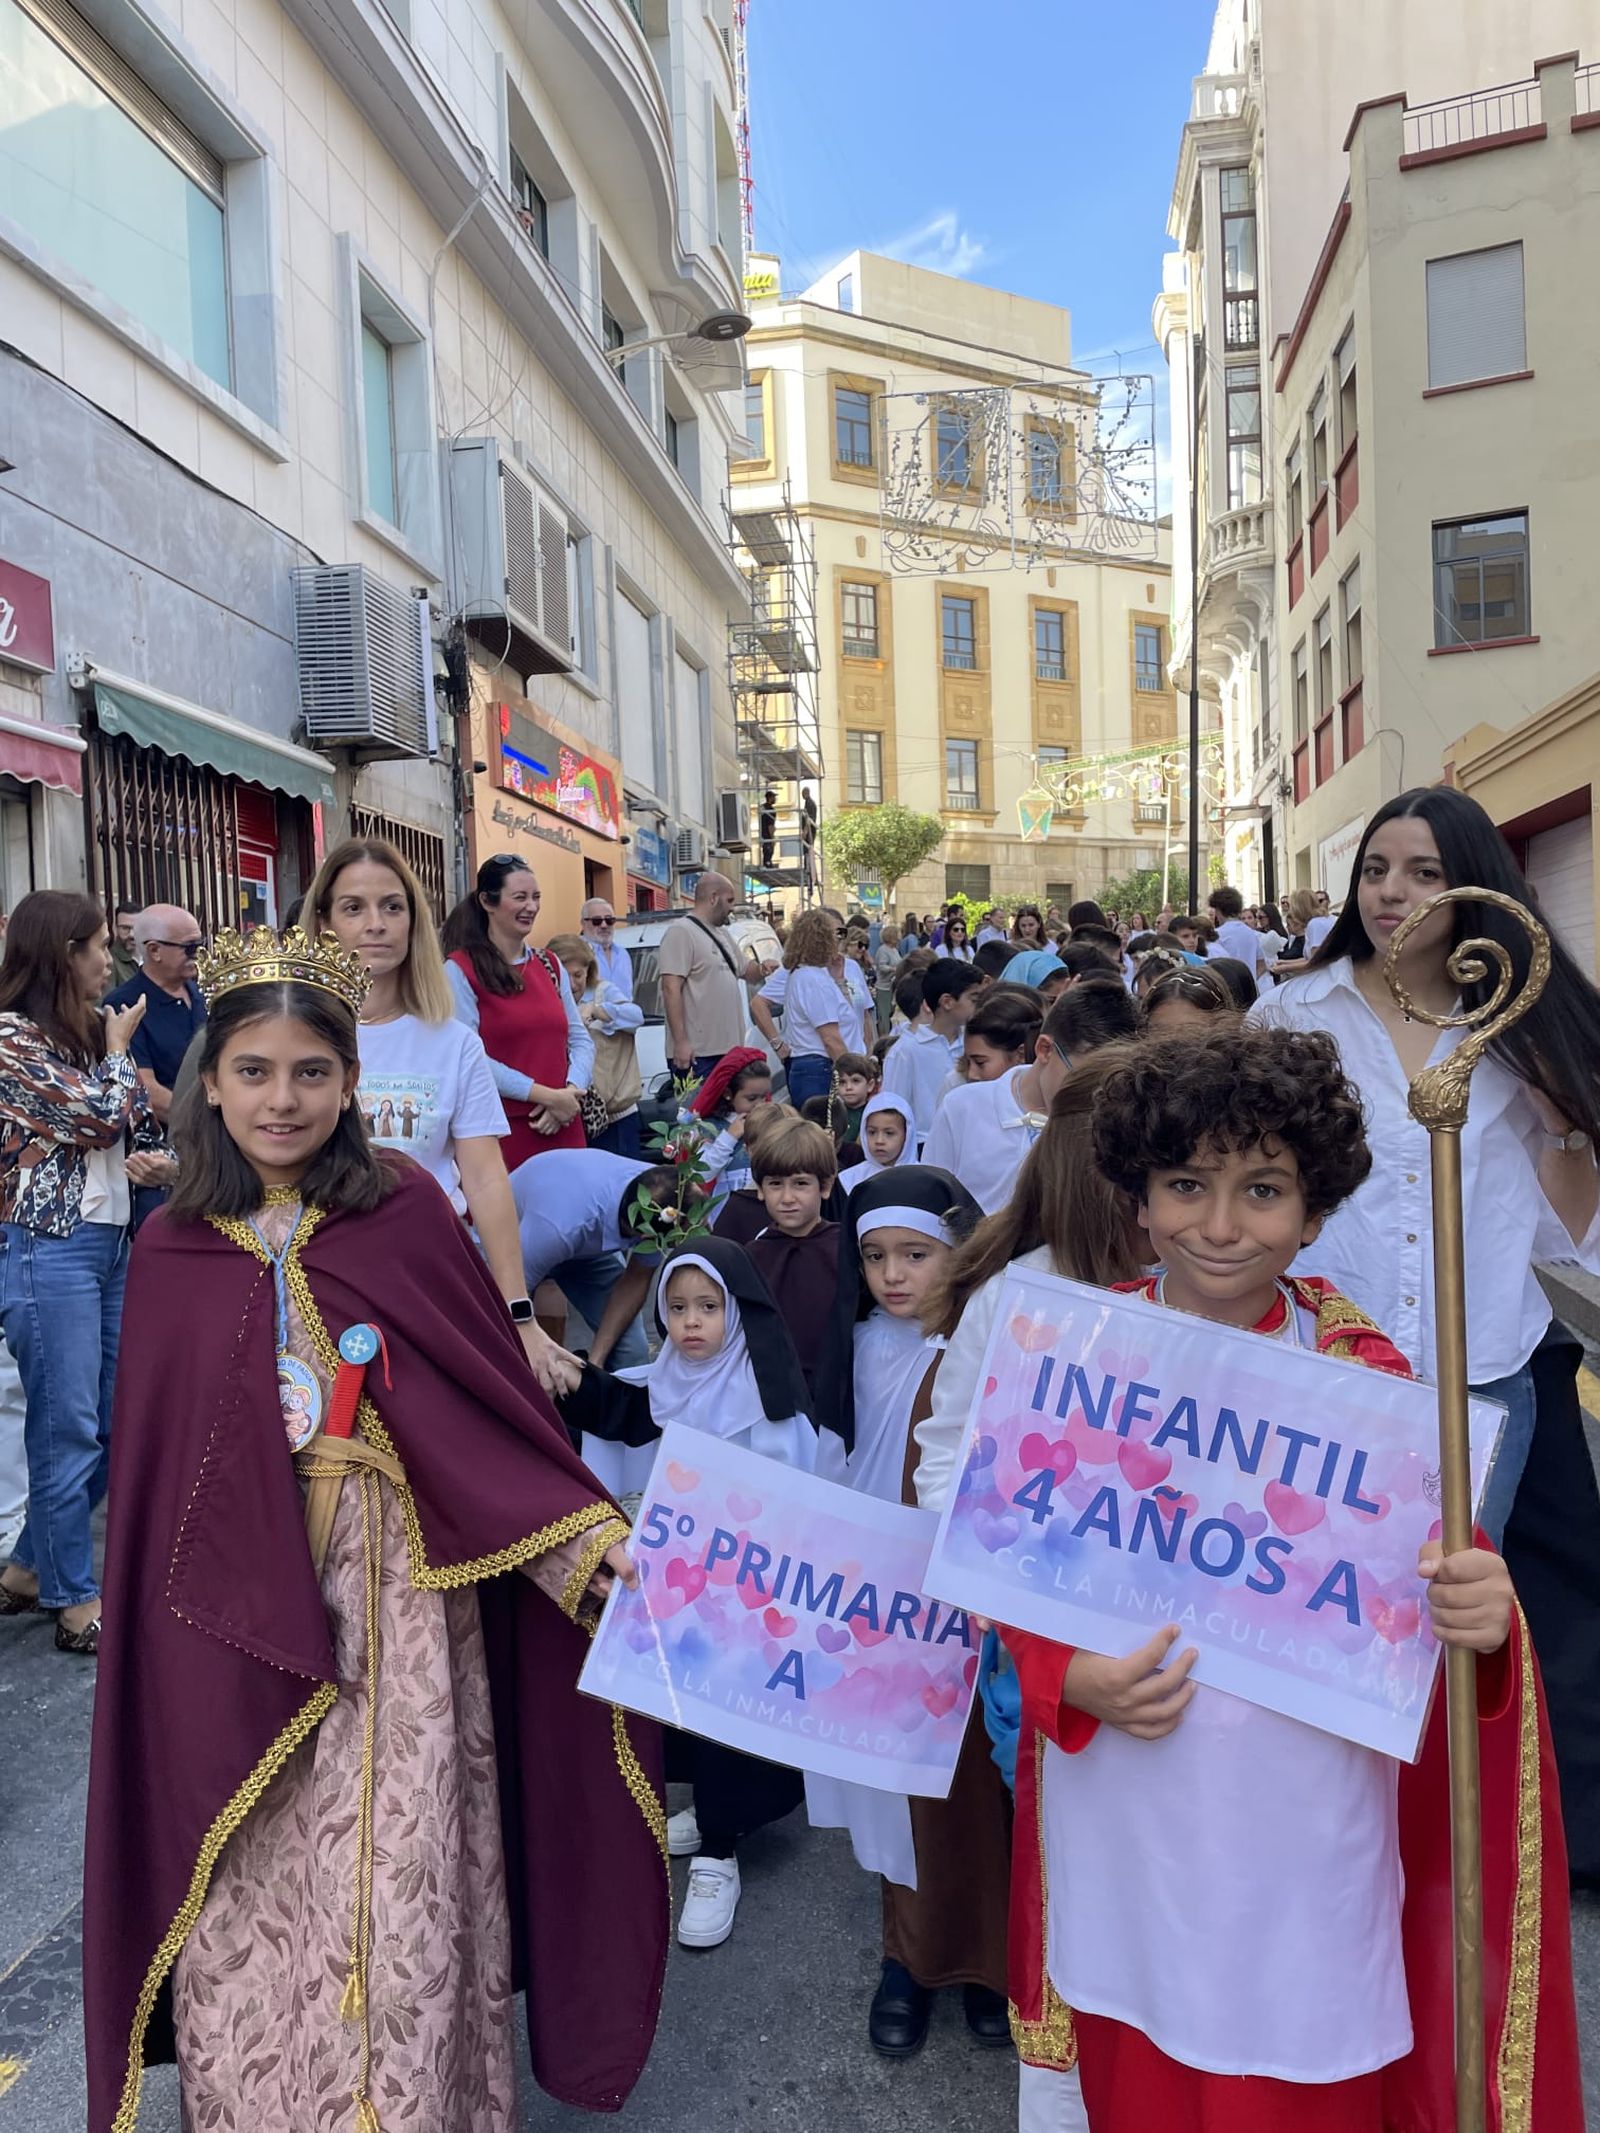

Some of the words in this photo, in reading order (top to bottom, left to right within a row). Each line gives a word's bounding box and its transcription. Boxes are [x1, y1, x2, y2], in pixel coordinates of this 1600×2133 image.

[1031, 1356, 1380, 1515] INFANTIL
[704, 1527, 972, 1648] PRIMARIA
[1012, 1468, 1057, 1525] 4
[1070, 1485, 1295, 1595] AÑOS
[1305, 1559, 1362, 1626] A
[996, 1547, 1037, 1578] CC
[1054, 1565, 1094, 1598] LA
[1113, 1584, 1354, 1676] INMACULADA
[683, 1670, 712, 1696] LA
[725, 1689, 912, 1757] INMACULADA
[765, 1649, 806, 1700] A
